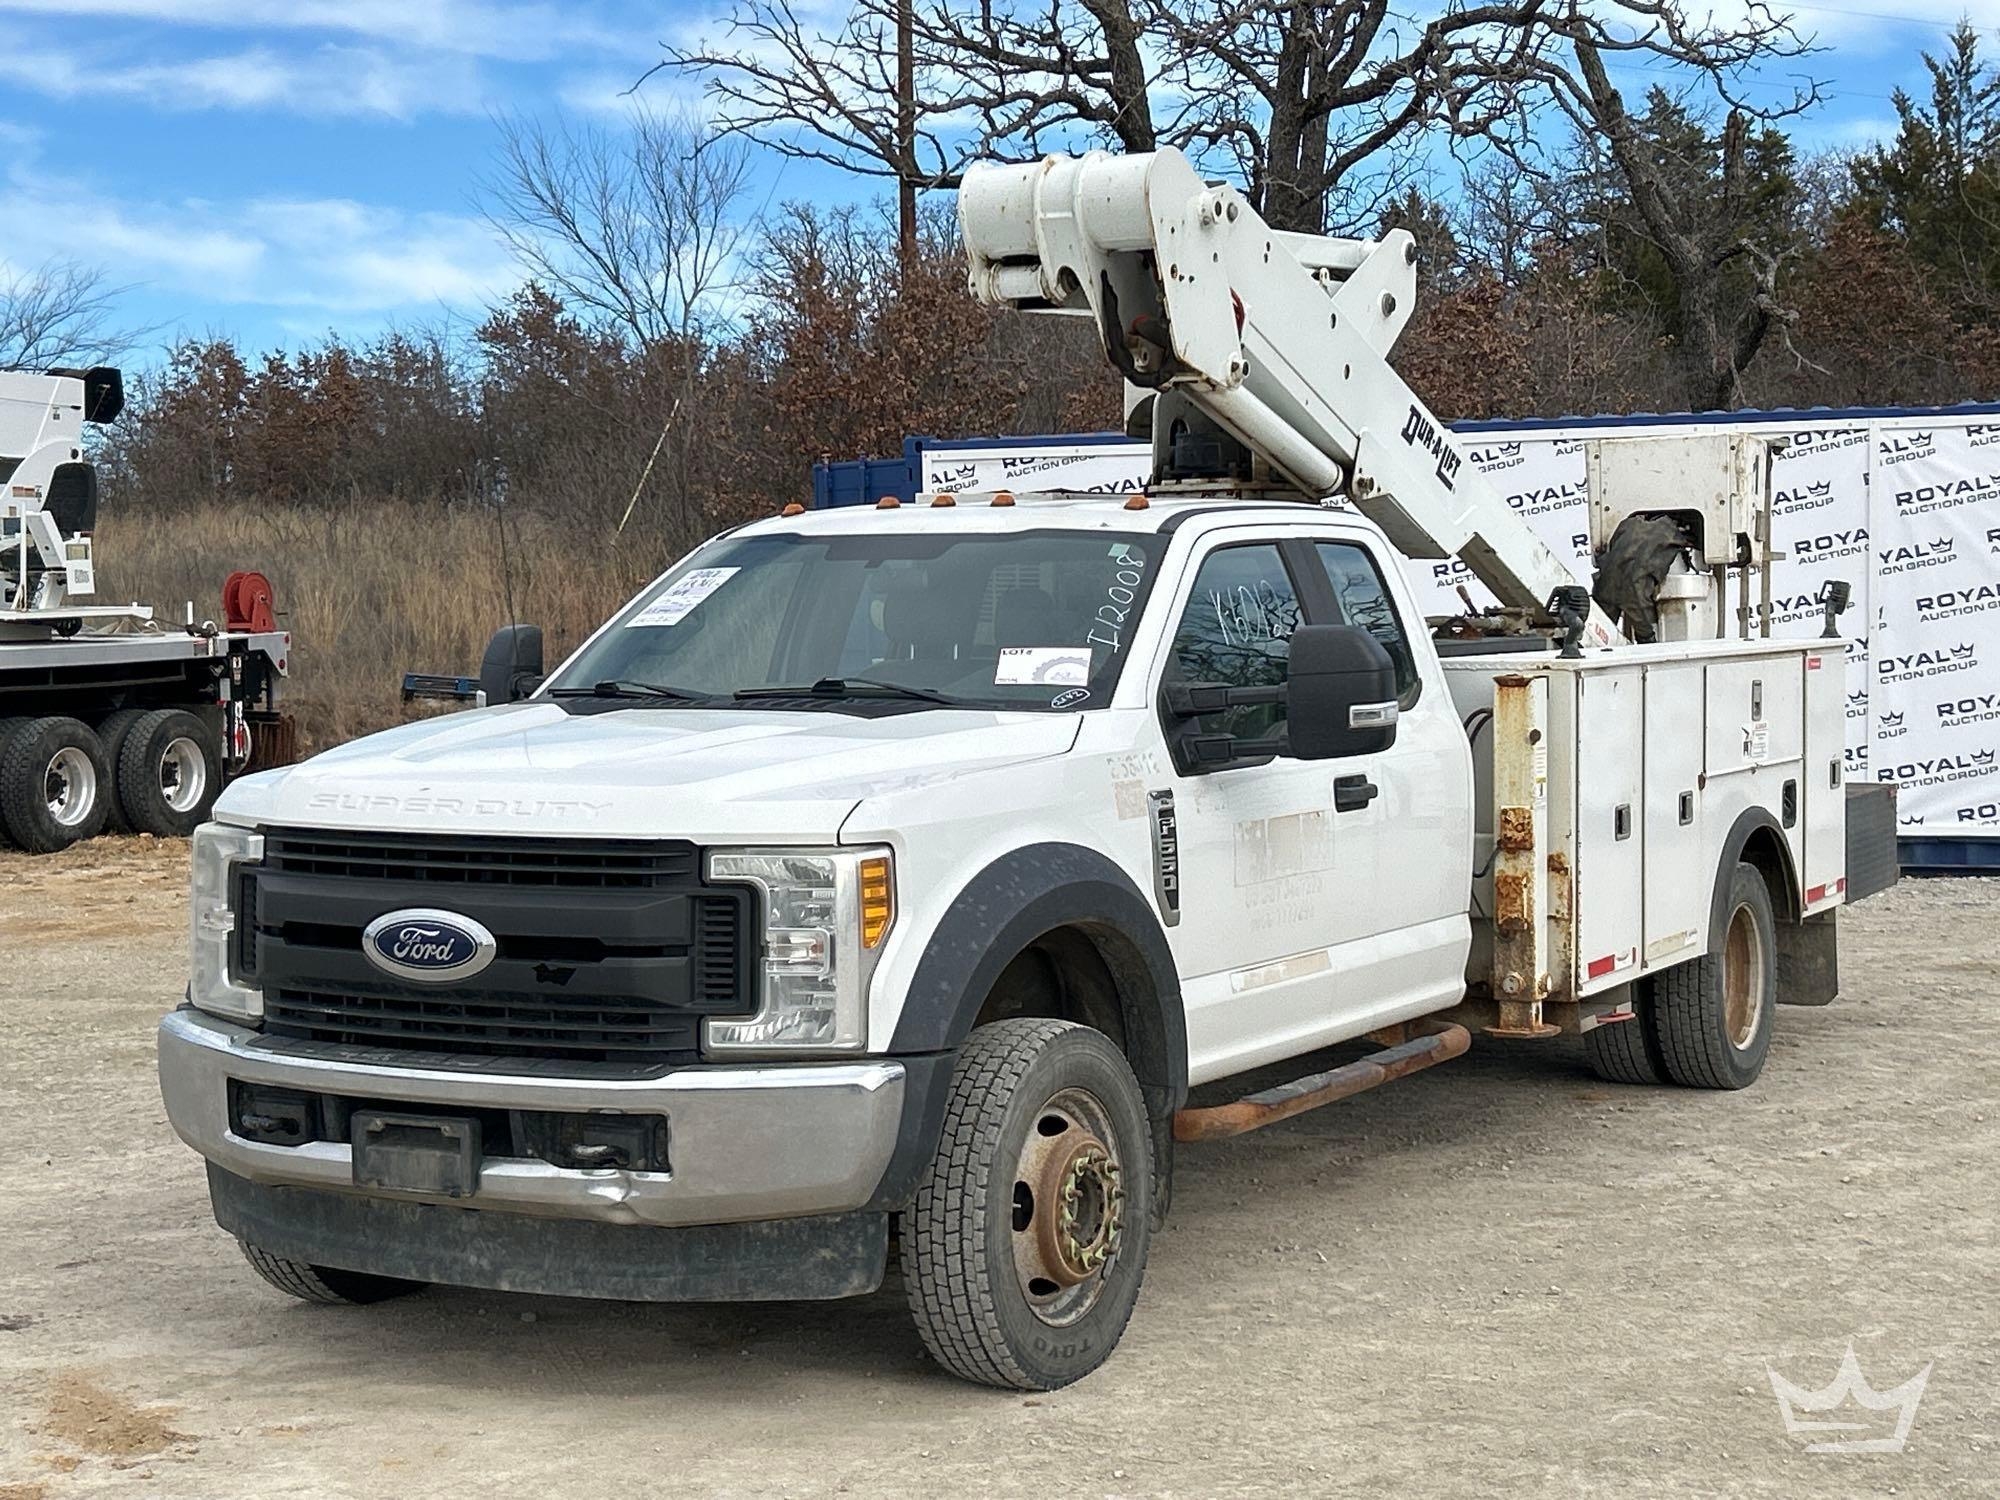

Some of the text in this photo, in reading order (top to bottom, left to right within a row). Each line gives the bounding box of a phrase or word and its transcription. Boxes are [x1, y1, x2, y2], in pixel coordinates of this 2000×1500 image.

[1778, 442, 1841, 461] AUCTION
[1885, 448, 1936, 465] GROUP
[1006, 461, 1059, 478] AUCTION
[1895, 477, 1990, 506] ROYAL
[1785, 497, 1834, 513] GROUP
[1900, 498, 1963, 517] AUCTION
[1799, 545, 1862, 565] AUCTION
[1906, 554, 1957, 570] GROUP
[1920, 604, 1985, 622] AUCTION
[1927, 660, 1978, 676] GROUP
[1878, 755, 1971, 782] ROYAL
[1947, 765, 1999, 781] GROUP
[308, 793, 614, 818] SUPER DUTY
[393, 926, 454, 962] Ford
